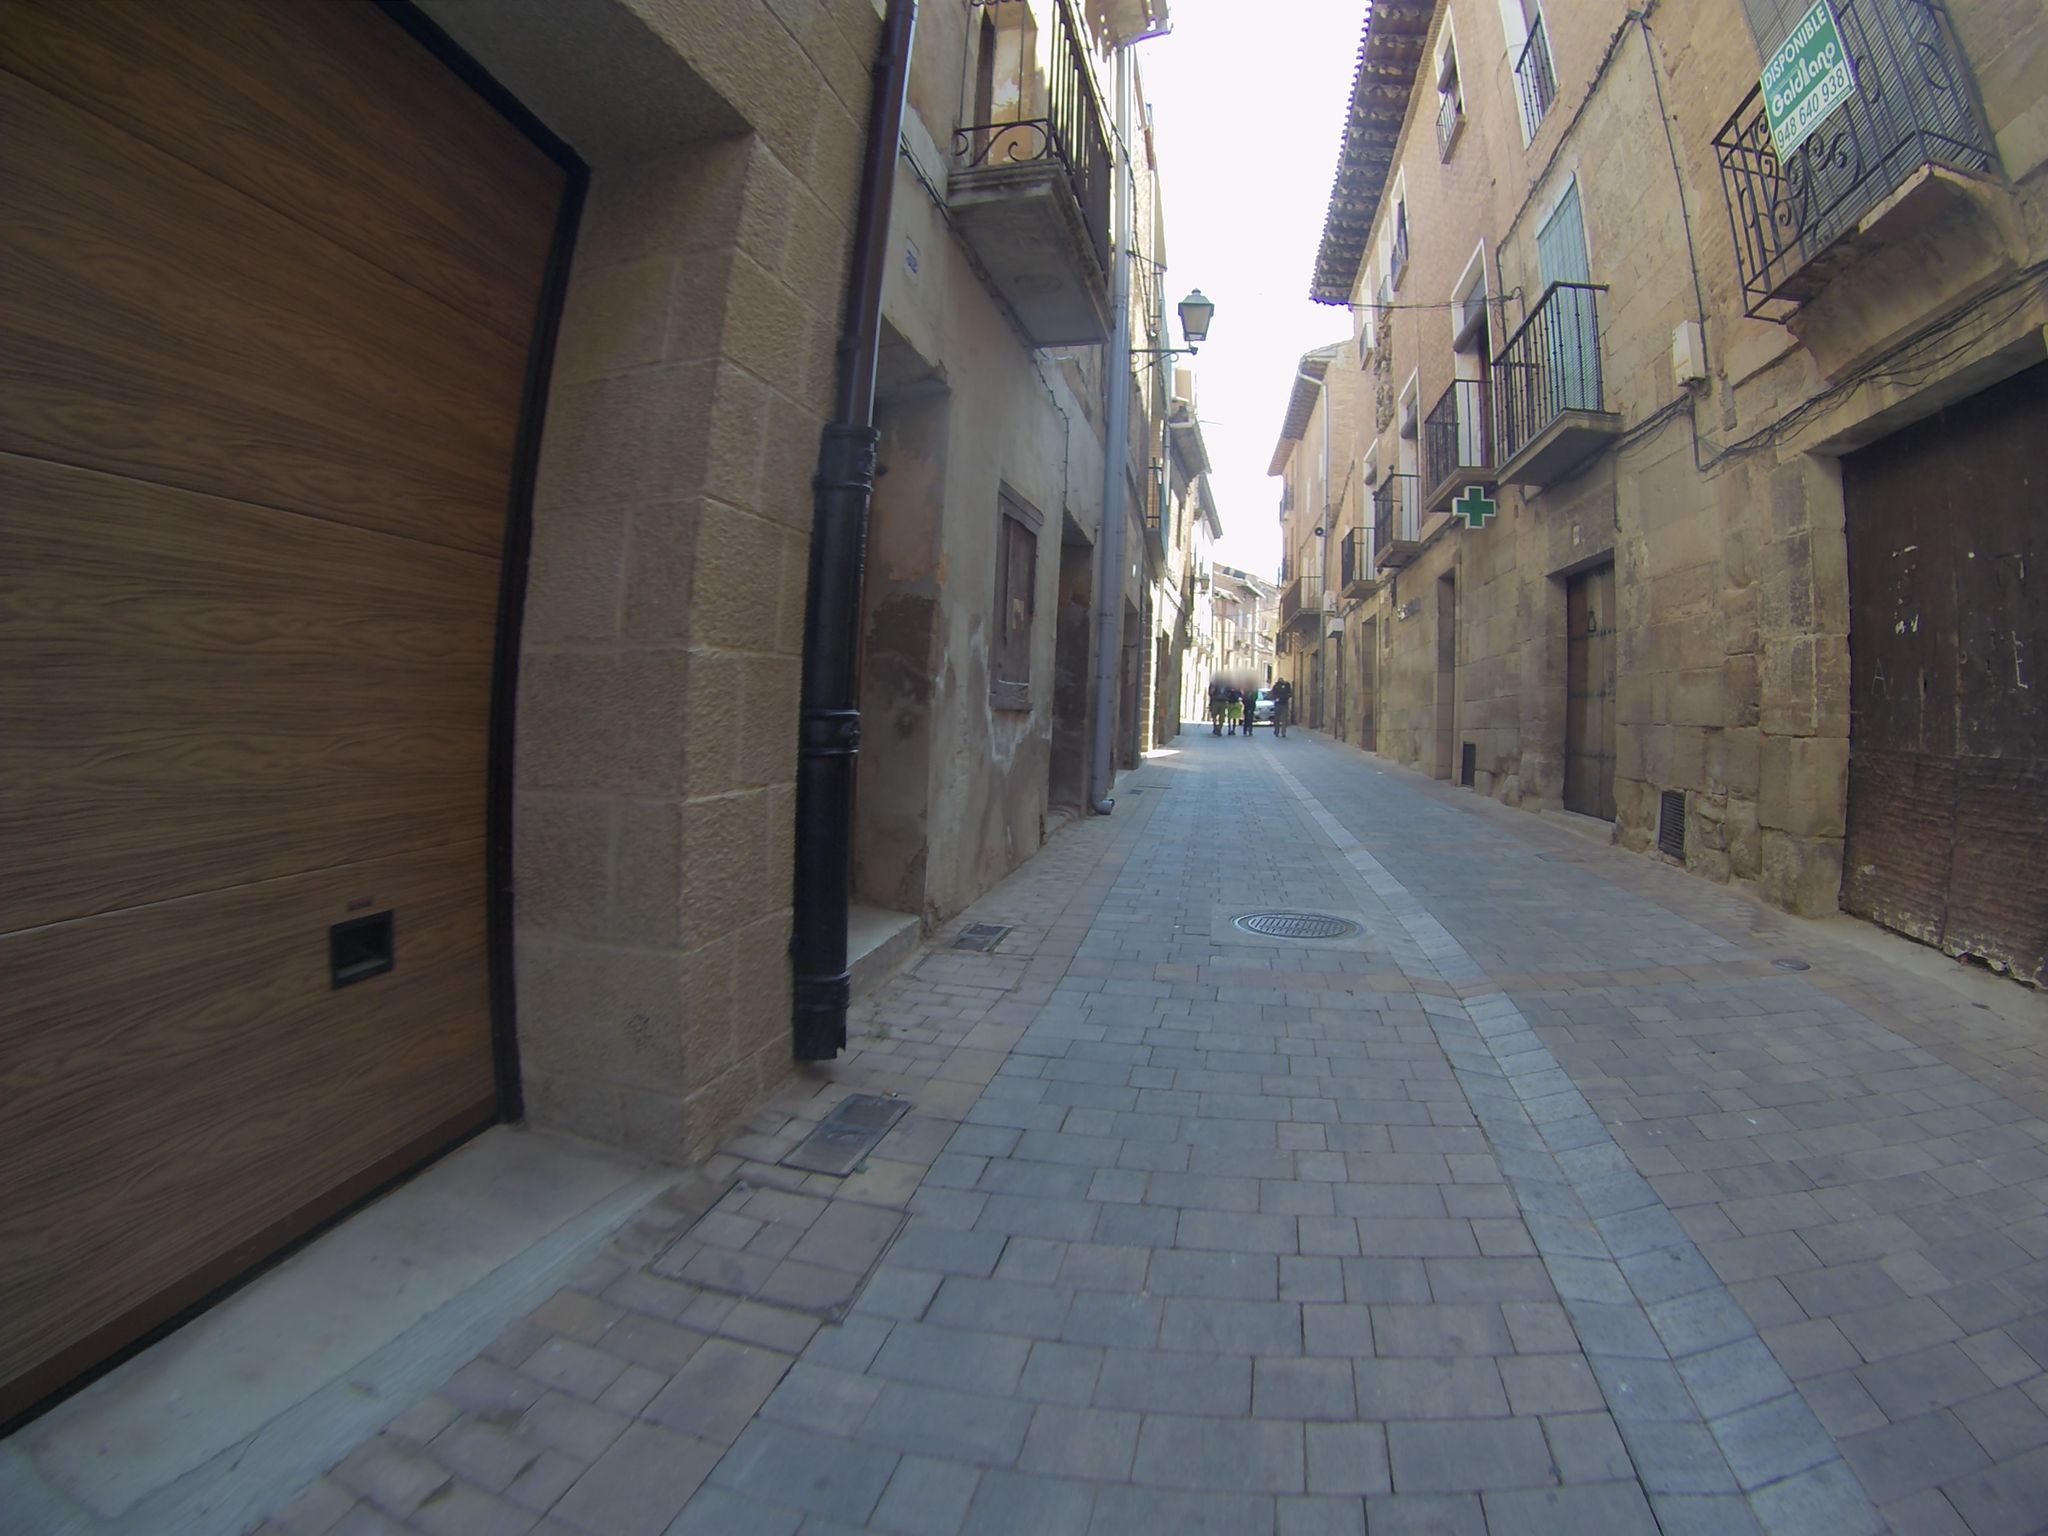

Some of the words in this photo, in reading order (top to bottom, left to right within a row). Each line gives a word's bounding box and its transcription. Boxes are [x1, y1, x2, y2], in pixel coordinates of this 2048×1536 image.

[1763, 6, 1827, 90] DISPONIBLE
[1777, 117, 1797, 149] 948
[1799, 93, 1820, 127] 640
[1822, 68, 1845, 103] 938
